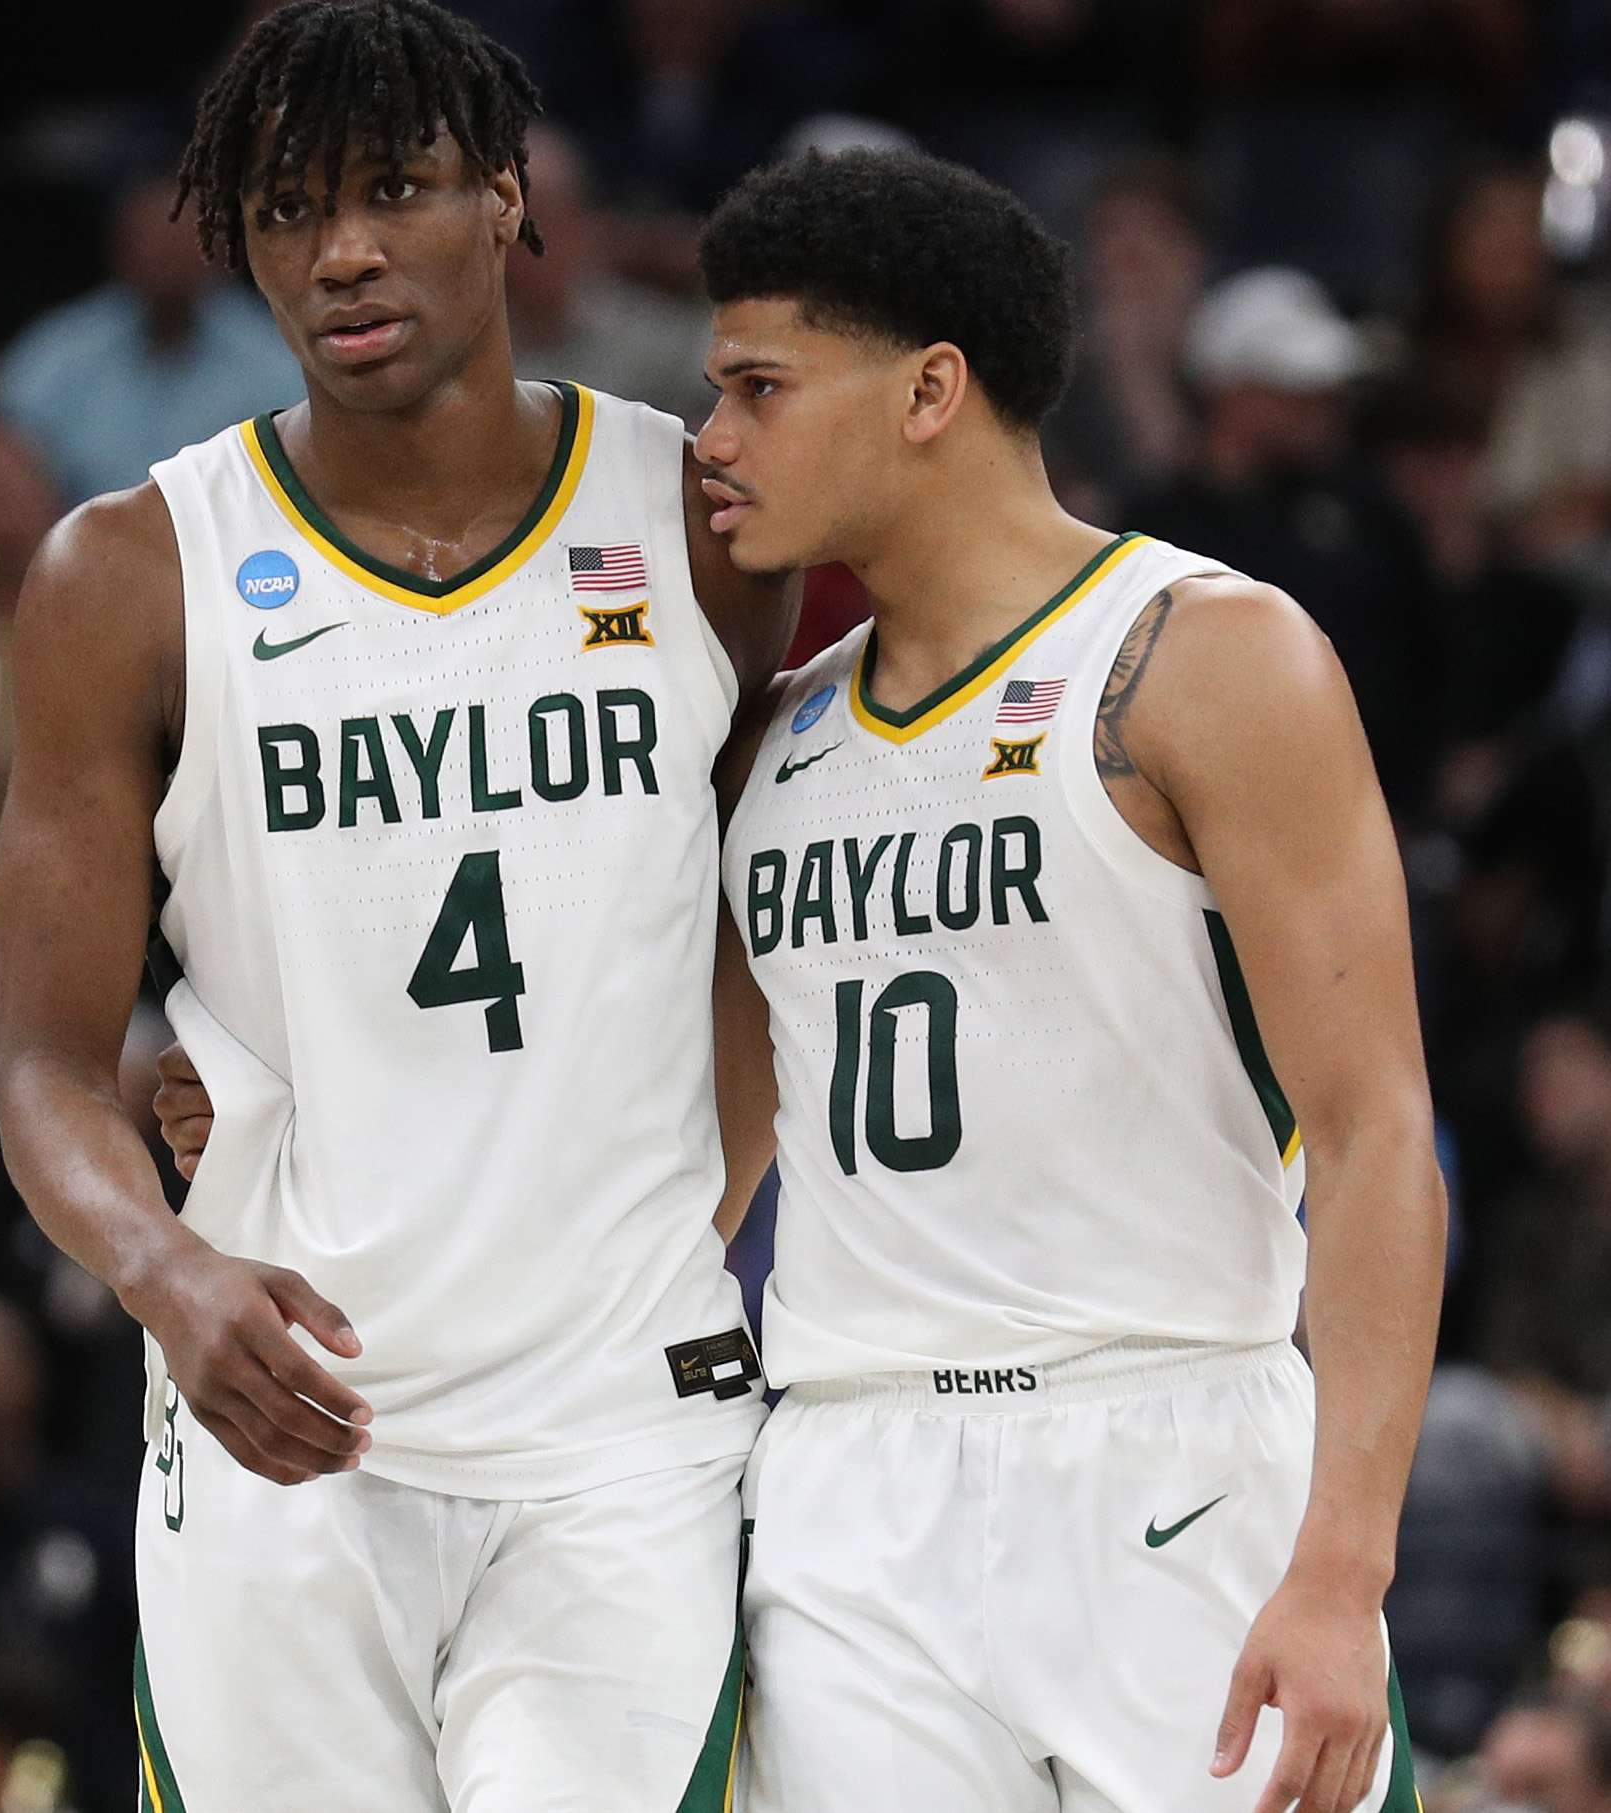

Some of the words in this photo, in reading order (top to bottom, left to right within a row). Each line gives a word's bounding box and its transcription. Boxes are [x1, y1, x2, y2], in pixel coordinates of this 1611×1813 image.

[244, 575, 295, 595] NCAA
[582, 606, 649, 646] XII
[257, 688, 660, 833] BAYLOR
[986, 738, 1042, 775] XII
[748, 815, 1050, 958] BAYLOR
[406, 849, 526, 1053] 4
[829, 970, 962, 1176] 10
[932, 1364, 1037, 1394] BEARS
